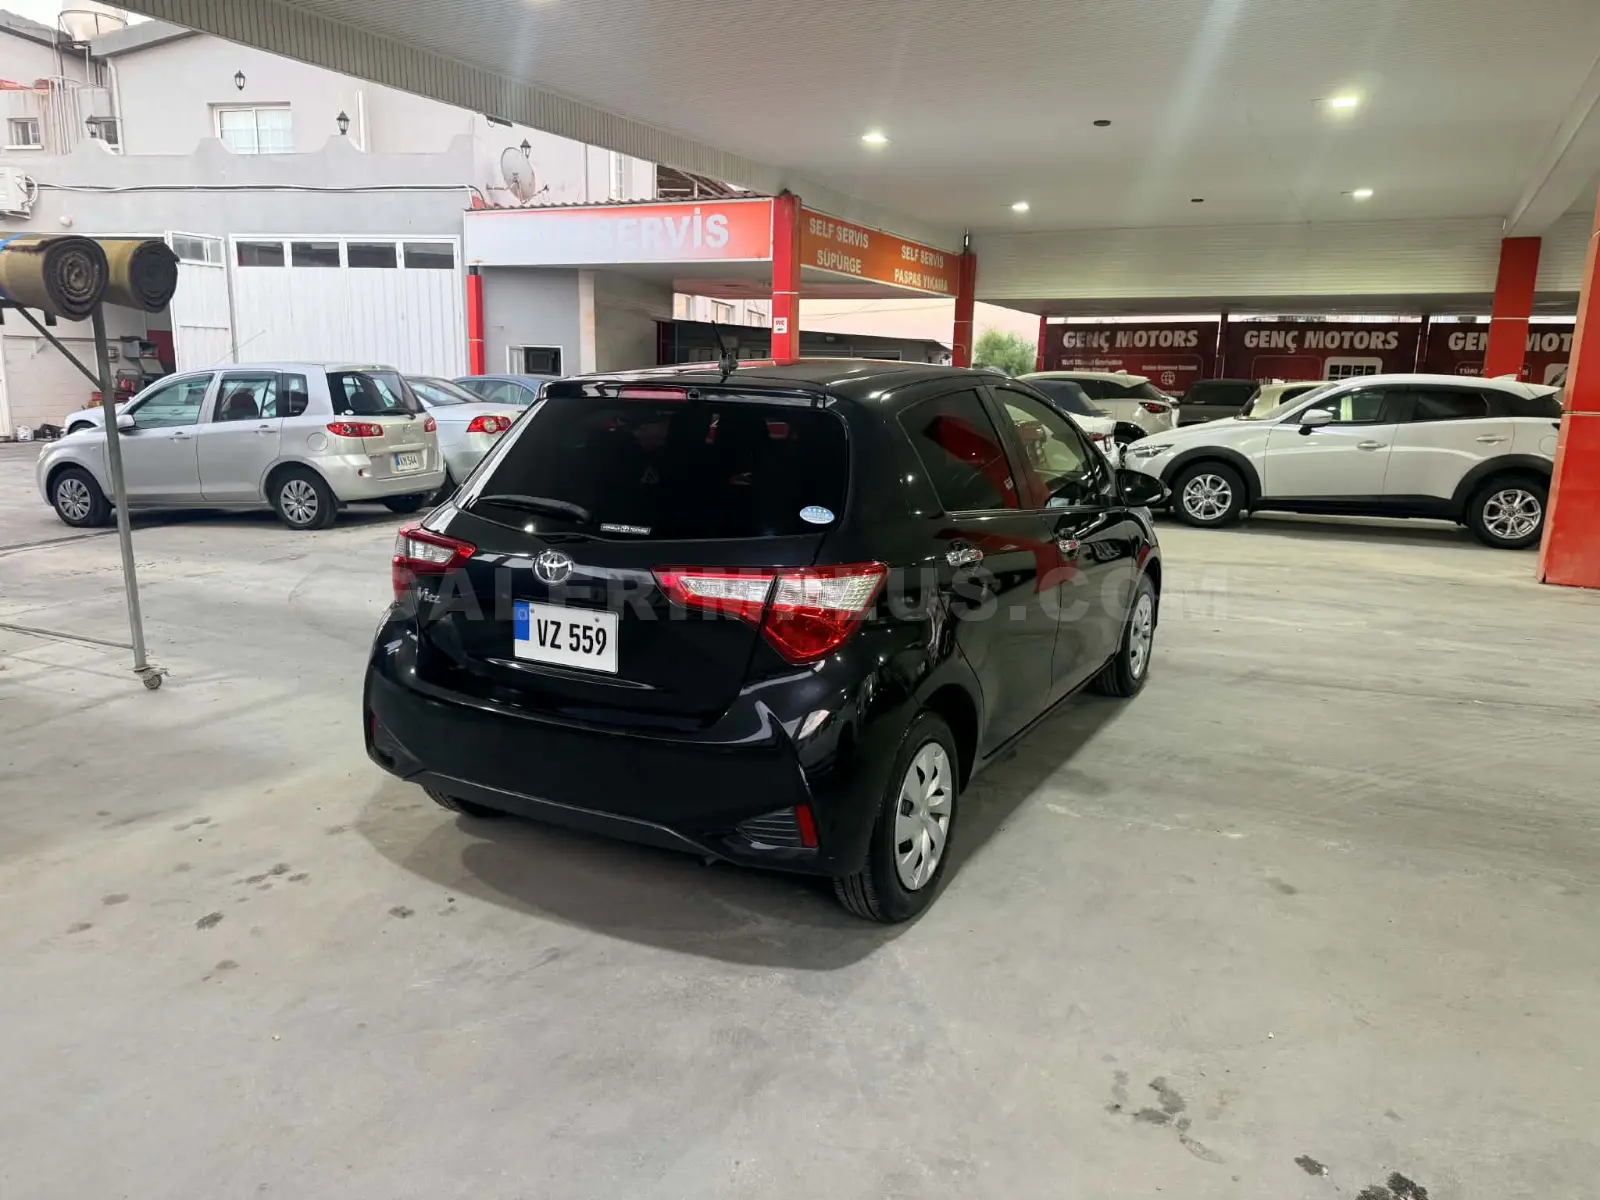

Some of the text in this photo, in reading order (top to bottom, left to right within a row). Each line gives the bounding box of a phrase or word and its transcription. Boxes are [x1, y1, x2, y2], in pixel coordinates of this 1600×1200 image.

[597, 208, 729, 249] SERVİS
[809, 218, 869, 249] SELF SERVİS
[816, 248, 862, 274] SÜPÜRGE
[901, 245, 919, 262] SELF
[894, 268, 921, 287] PASPAS
[1062, 330, 1198, 353] GENÇ MOTORS
[1244, 330, 1399, 353] GENÇ MOTORS
[1448, 332, 1574, 352] GEN MOT
[537, 618, 607, 656] VZ 559
